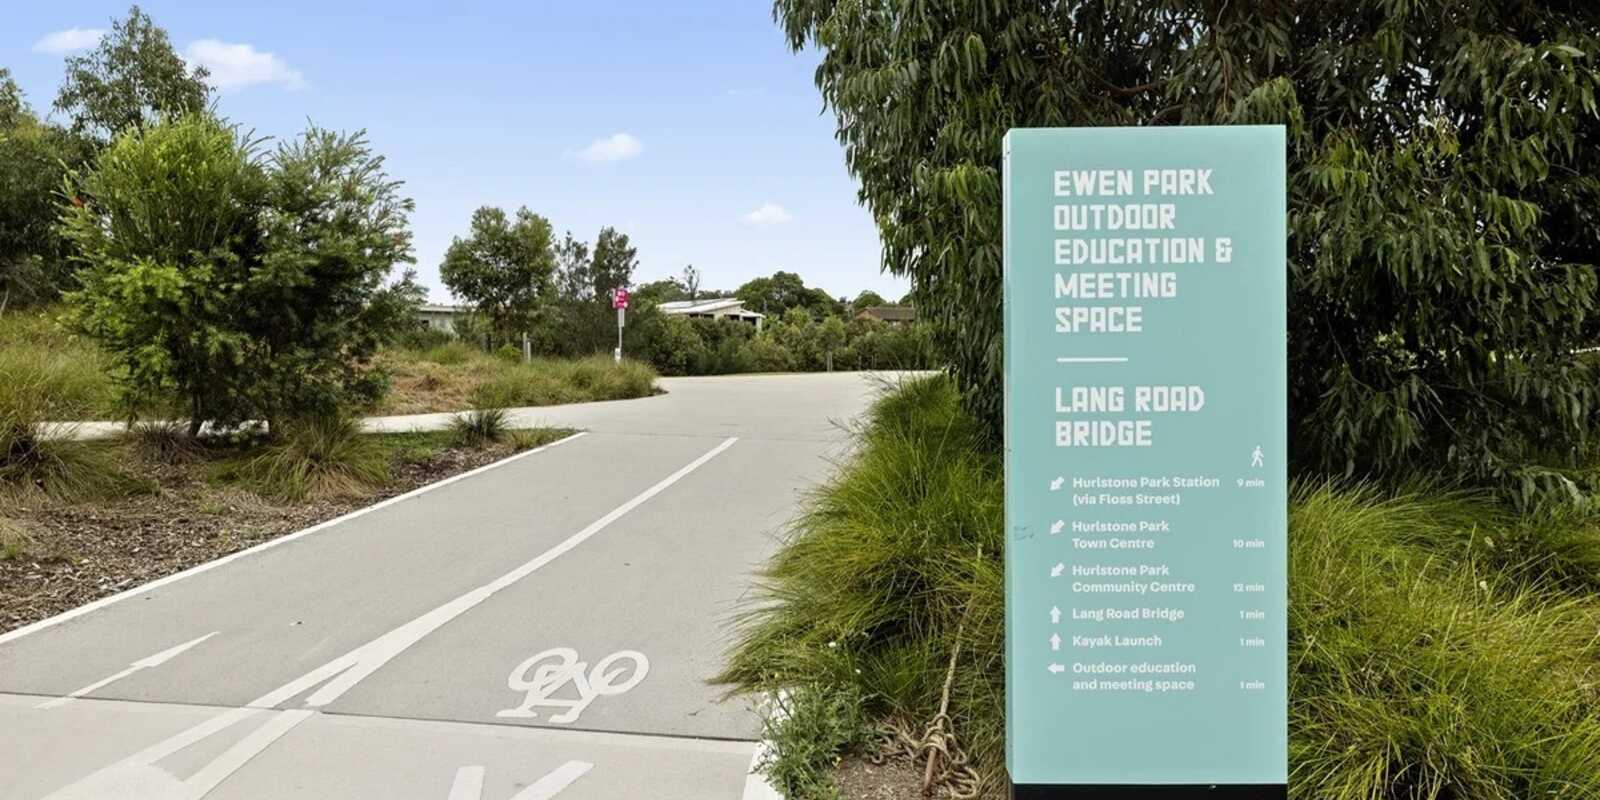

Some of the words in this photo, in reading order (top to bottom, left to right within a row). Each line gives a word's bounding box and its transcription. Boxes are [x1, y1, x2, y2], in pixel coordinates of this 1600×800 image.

[1054, 170, 1133, 196] EWEN
[1144, 169, 1214, 195] PARK
[1054, 204, 1175, 230] OUTDOOR
[1055, 238, 1204, 264] EDUCATION
[1216, 238, 1232, 263] &
[1055, 272, 1176, 298] MEETING
[1055, 307, 1142, 332] SPACE
[1056, 387, 1124, 412] LANG
[1136, 386, 1204, 411] ROAD
[1056, 420, 1152, 446] BRIDGE
[1073, 477, 1137, 488] Hurlstone
[1141, 477, 1170, 487] Park
[1173, 476, 1219, 487] Station
[1236, 478, 1244, 487] 9
[1246, 478, 1264, 487] min
[1073, 494, 1096, 506] (via
[1099, 495, 1133, 504] Floss
[1136, 494, 1180, 505] Street)
[1072, 521, 1137, 532] Hurlstone
[1140, 521, 1168, 531] Park
[1072, 538, 1107, 548] Town
[1109, 538, 1154, 548] Centre
[1233, 539, 1244, 548] 10
[1246, 539, 1264, 547] min
[1072, 565, 1136, 575] Hurlstone
[1140, 565, 1169, 575] Park
[1072, 581, 1147, 594] Community
[1150, 582, 1194, 592] Centre
[1246, 583, 1264, 591] min
[1073, 609, 1104, 621] Lang
[1106, 608, 1139, 619] Road
[1142, 608, 1184, 621] Bridge
[1240, 610, 1244, 619] 1
[1246, 610, 1264, 619] min
[1073, 635, 1112, 648] Kayak
[1115, 635, 1161, 646] Launch
[1240, 638, 1244, 647] 1
[1246, 637, 1264, 646] min
[1073, 662, 1127, 673] Outdoor
[1130, 662, 1196, 673] education
[1073, 679, 1097, 690] and
[1100, 679, 1153, 692] meeting
[1154, 681, 1195, 692] space
[1240, 681, 1244, 690] 1
[1246, 680, 1264, 689] min
